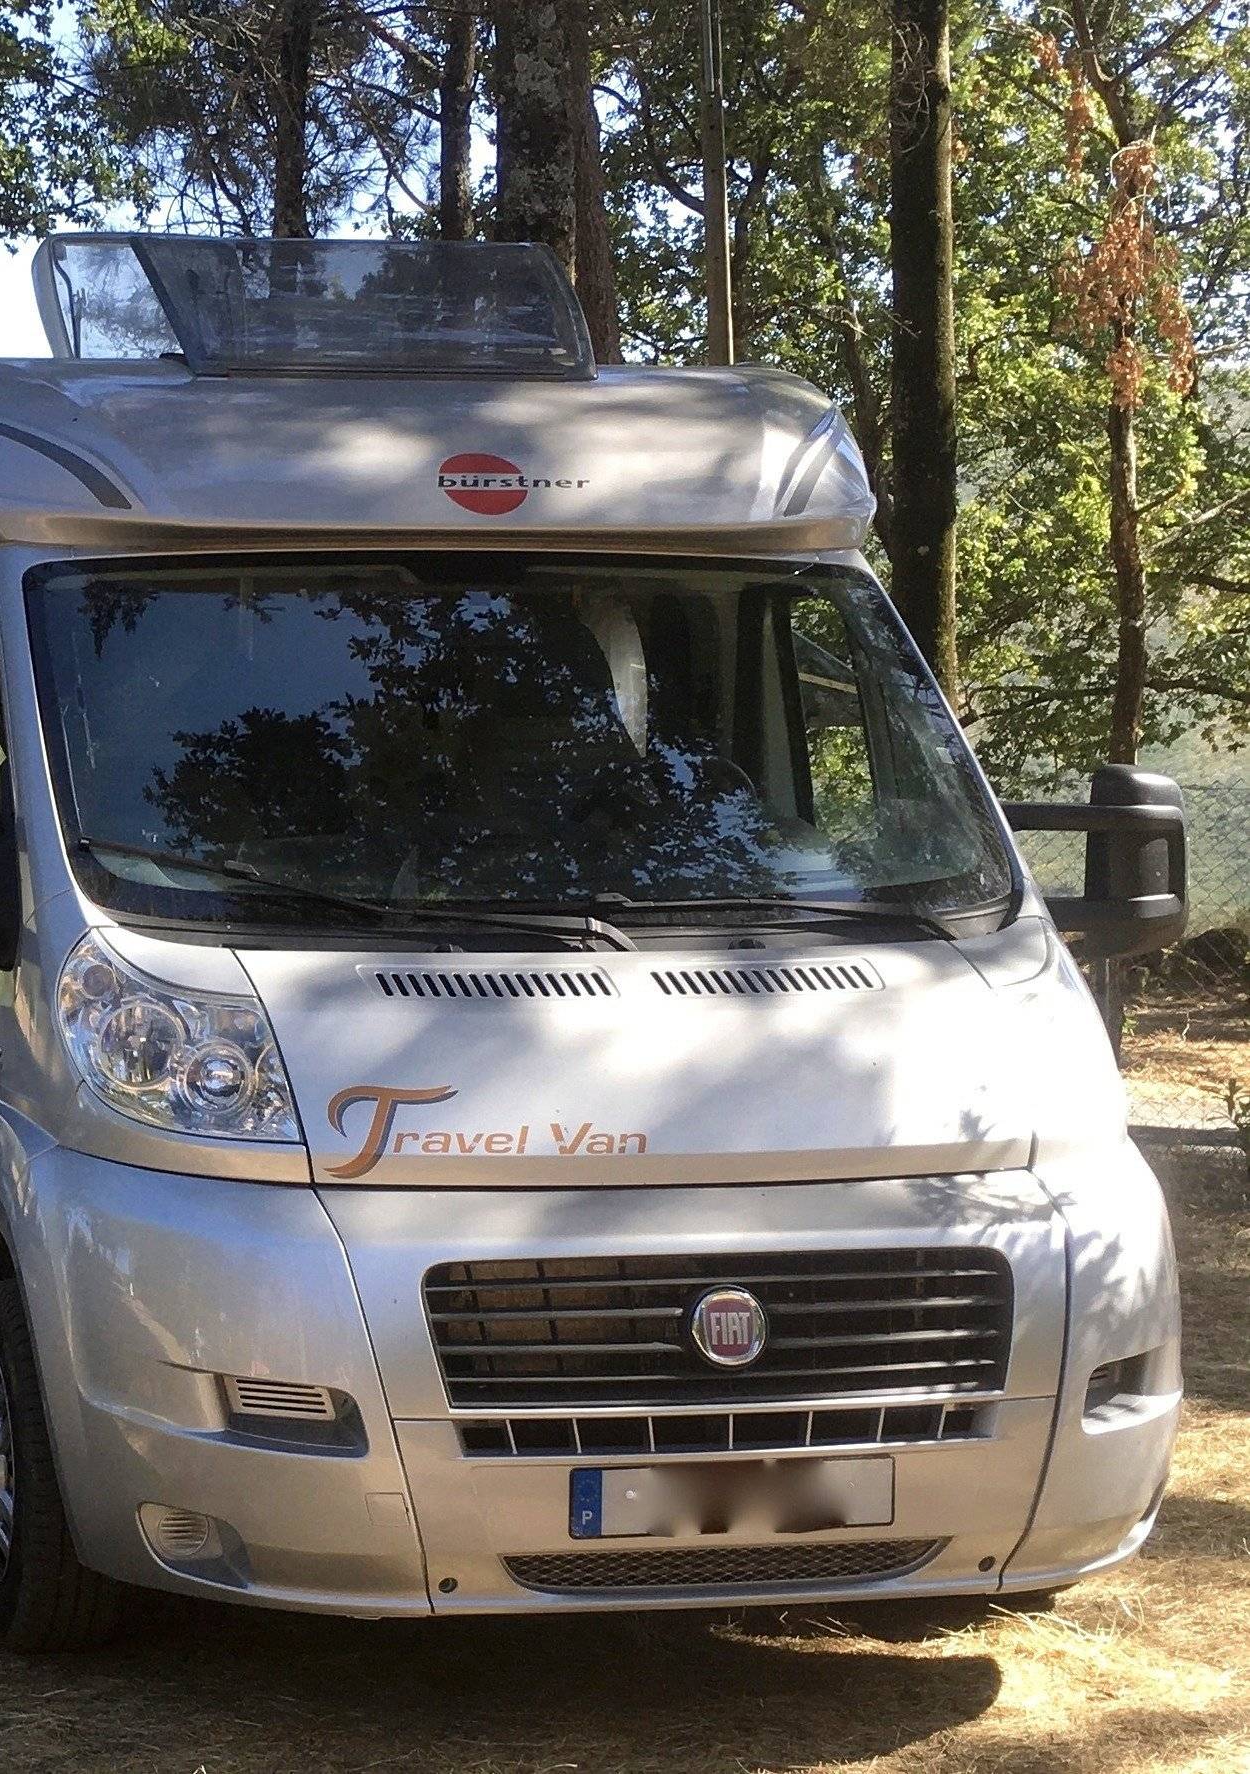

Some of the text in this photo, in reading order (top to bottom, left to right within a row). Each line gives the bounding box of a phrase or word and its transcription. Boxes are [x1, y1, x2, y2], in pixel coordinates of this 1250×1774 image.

[437, 475, 590, 489] bürstner
[322, 1085, 648, 1179] Travel Van
[710, 1312, 750, 1345] FIAT
[582, 1510, 593, 1525] P
